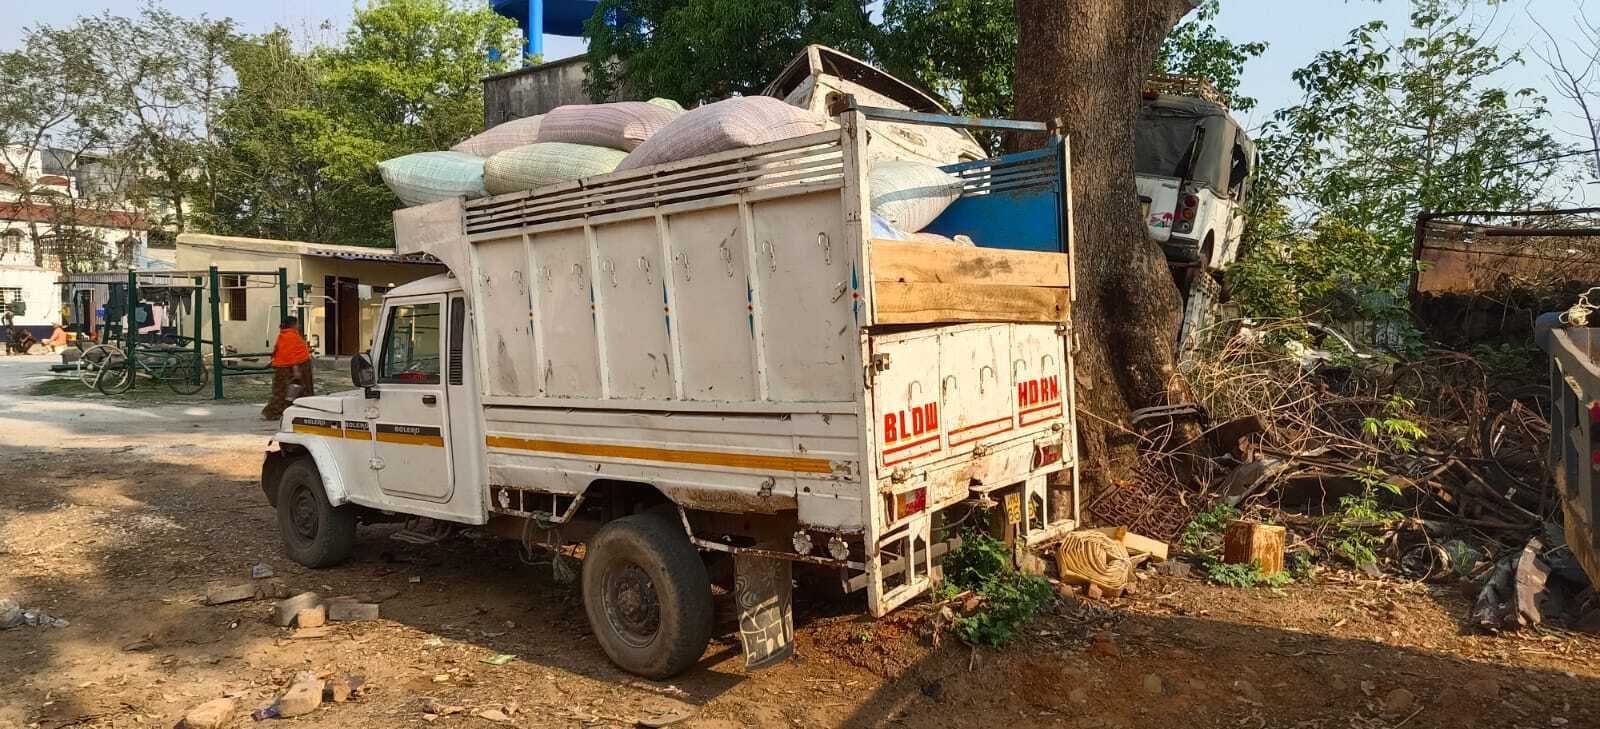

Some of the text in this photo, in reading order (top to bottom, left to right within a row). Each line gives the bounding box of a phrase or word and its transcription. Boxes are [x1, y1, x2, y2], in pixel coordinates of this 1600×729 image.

[884, 374, 1058, 443] BLOW HORN
[394, 426, 420, 435] BOLERO
